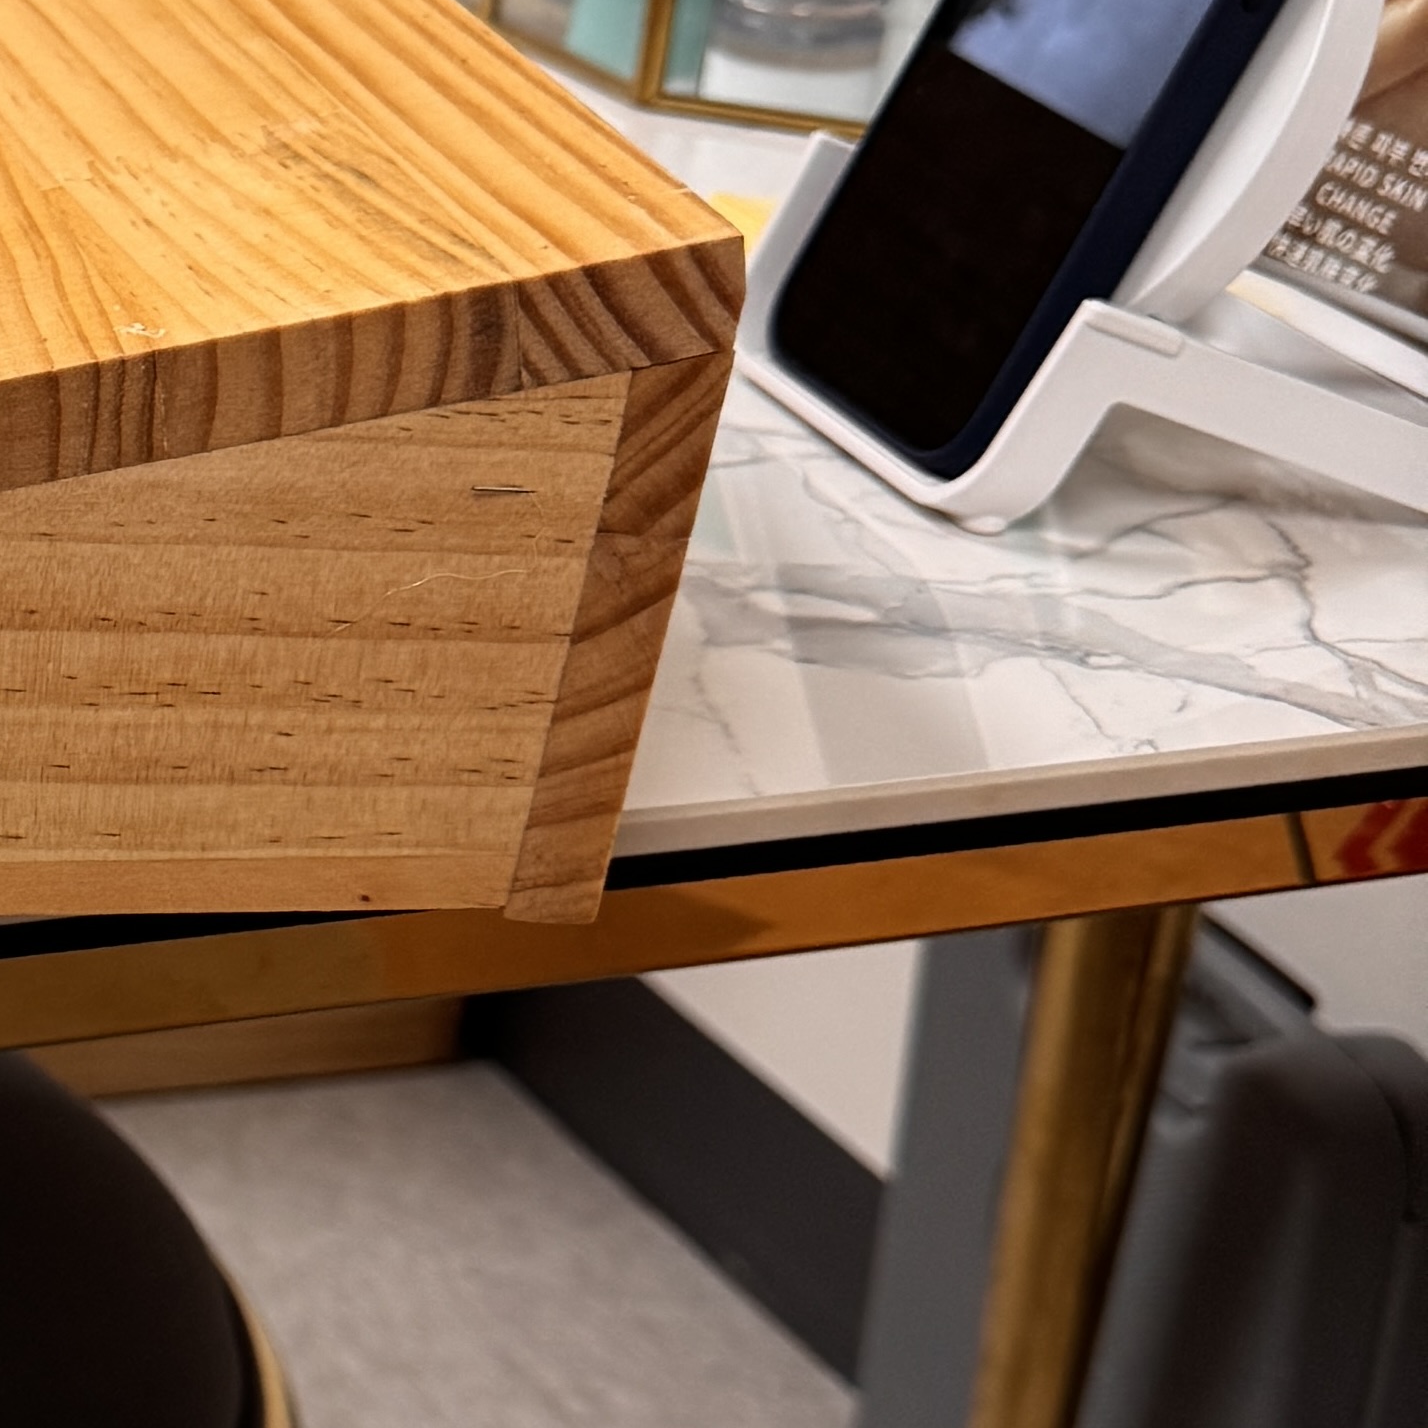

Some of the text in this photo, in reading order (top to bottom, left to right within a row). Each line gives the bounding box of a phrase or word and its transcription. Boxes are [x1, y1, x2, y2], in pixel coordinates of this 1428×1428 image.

[1315, 180, 1396, 235] CHANGE
[1324, 151, 1428, 213] APID SKIN
